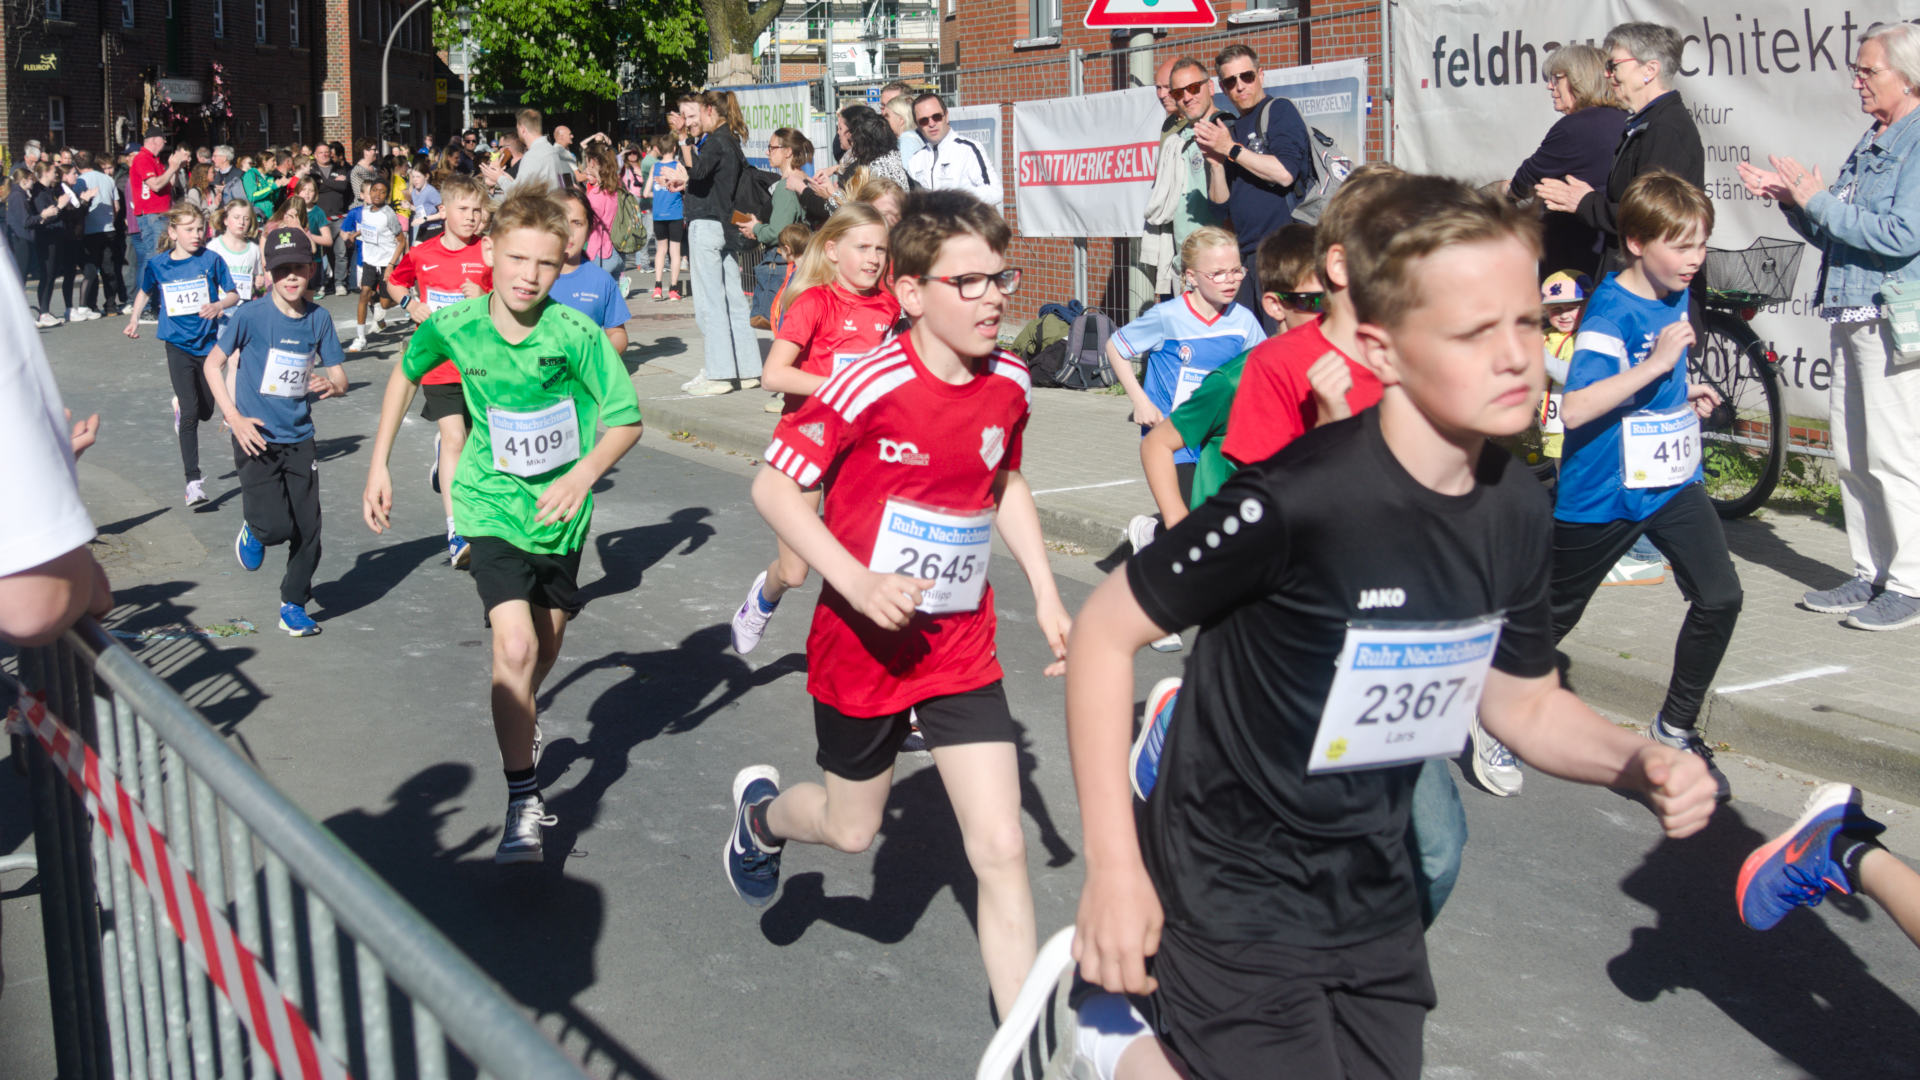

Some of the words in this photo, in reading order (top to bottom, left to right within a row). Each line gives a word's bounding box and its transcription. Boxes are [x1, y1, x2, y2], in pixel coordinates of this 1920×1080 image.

[1020, 150, 1115, 183] STADTWERKE
[176, 291, 199, 304] 412
[464, 368, 487, 377] JAKO
[1633, 424, 1658, 434] Ruhr
[504, 429, 563, 457] 4109
[1653, 436, 1691, 463] 416
[526, 458, 546, 467] Mika
[891, 515, 926, 537] Ruhr
[894, 547, 976, 584] 2645
[921, 589, 952, 600] hilipp
[1357, 588, 1406, 609] JAKO
[1356, 645, 1401, 667] Ruhr
[1402, 638, 1491, 666] Nachrichten
[1355, 676, 1467, 726] 2367
[1385, 731, 1415, 744] Lars
